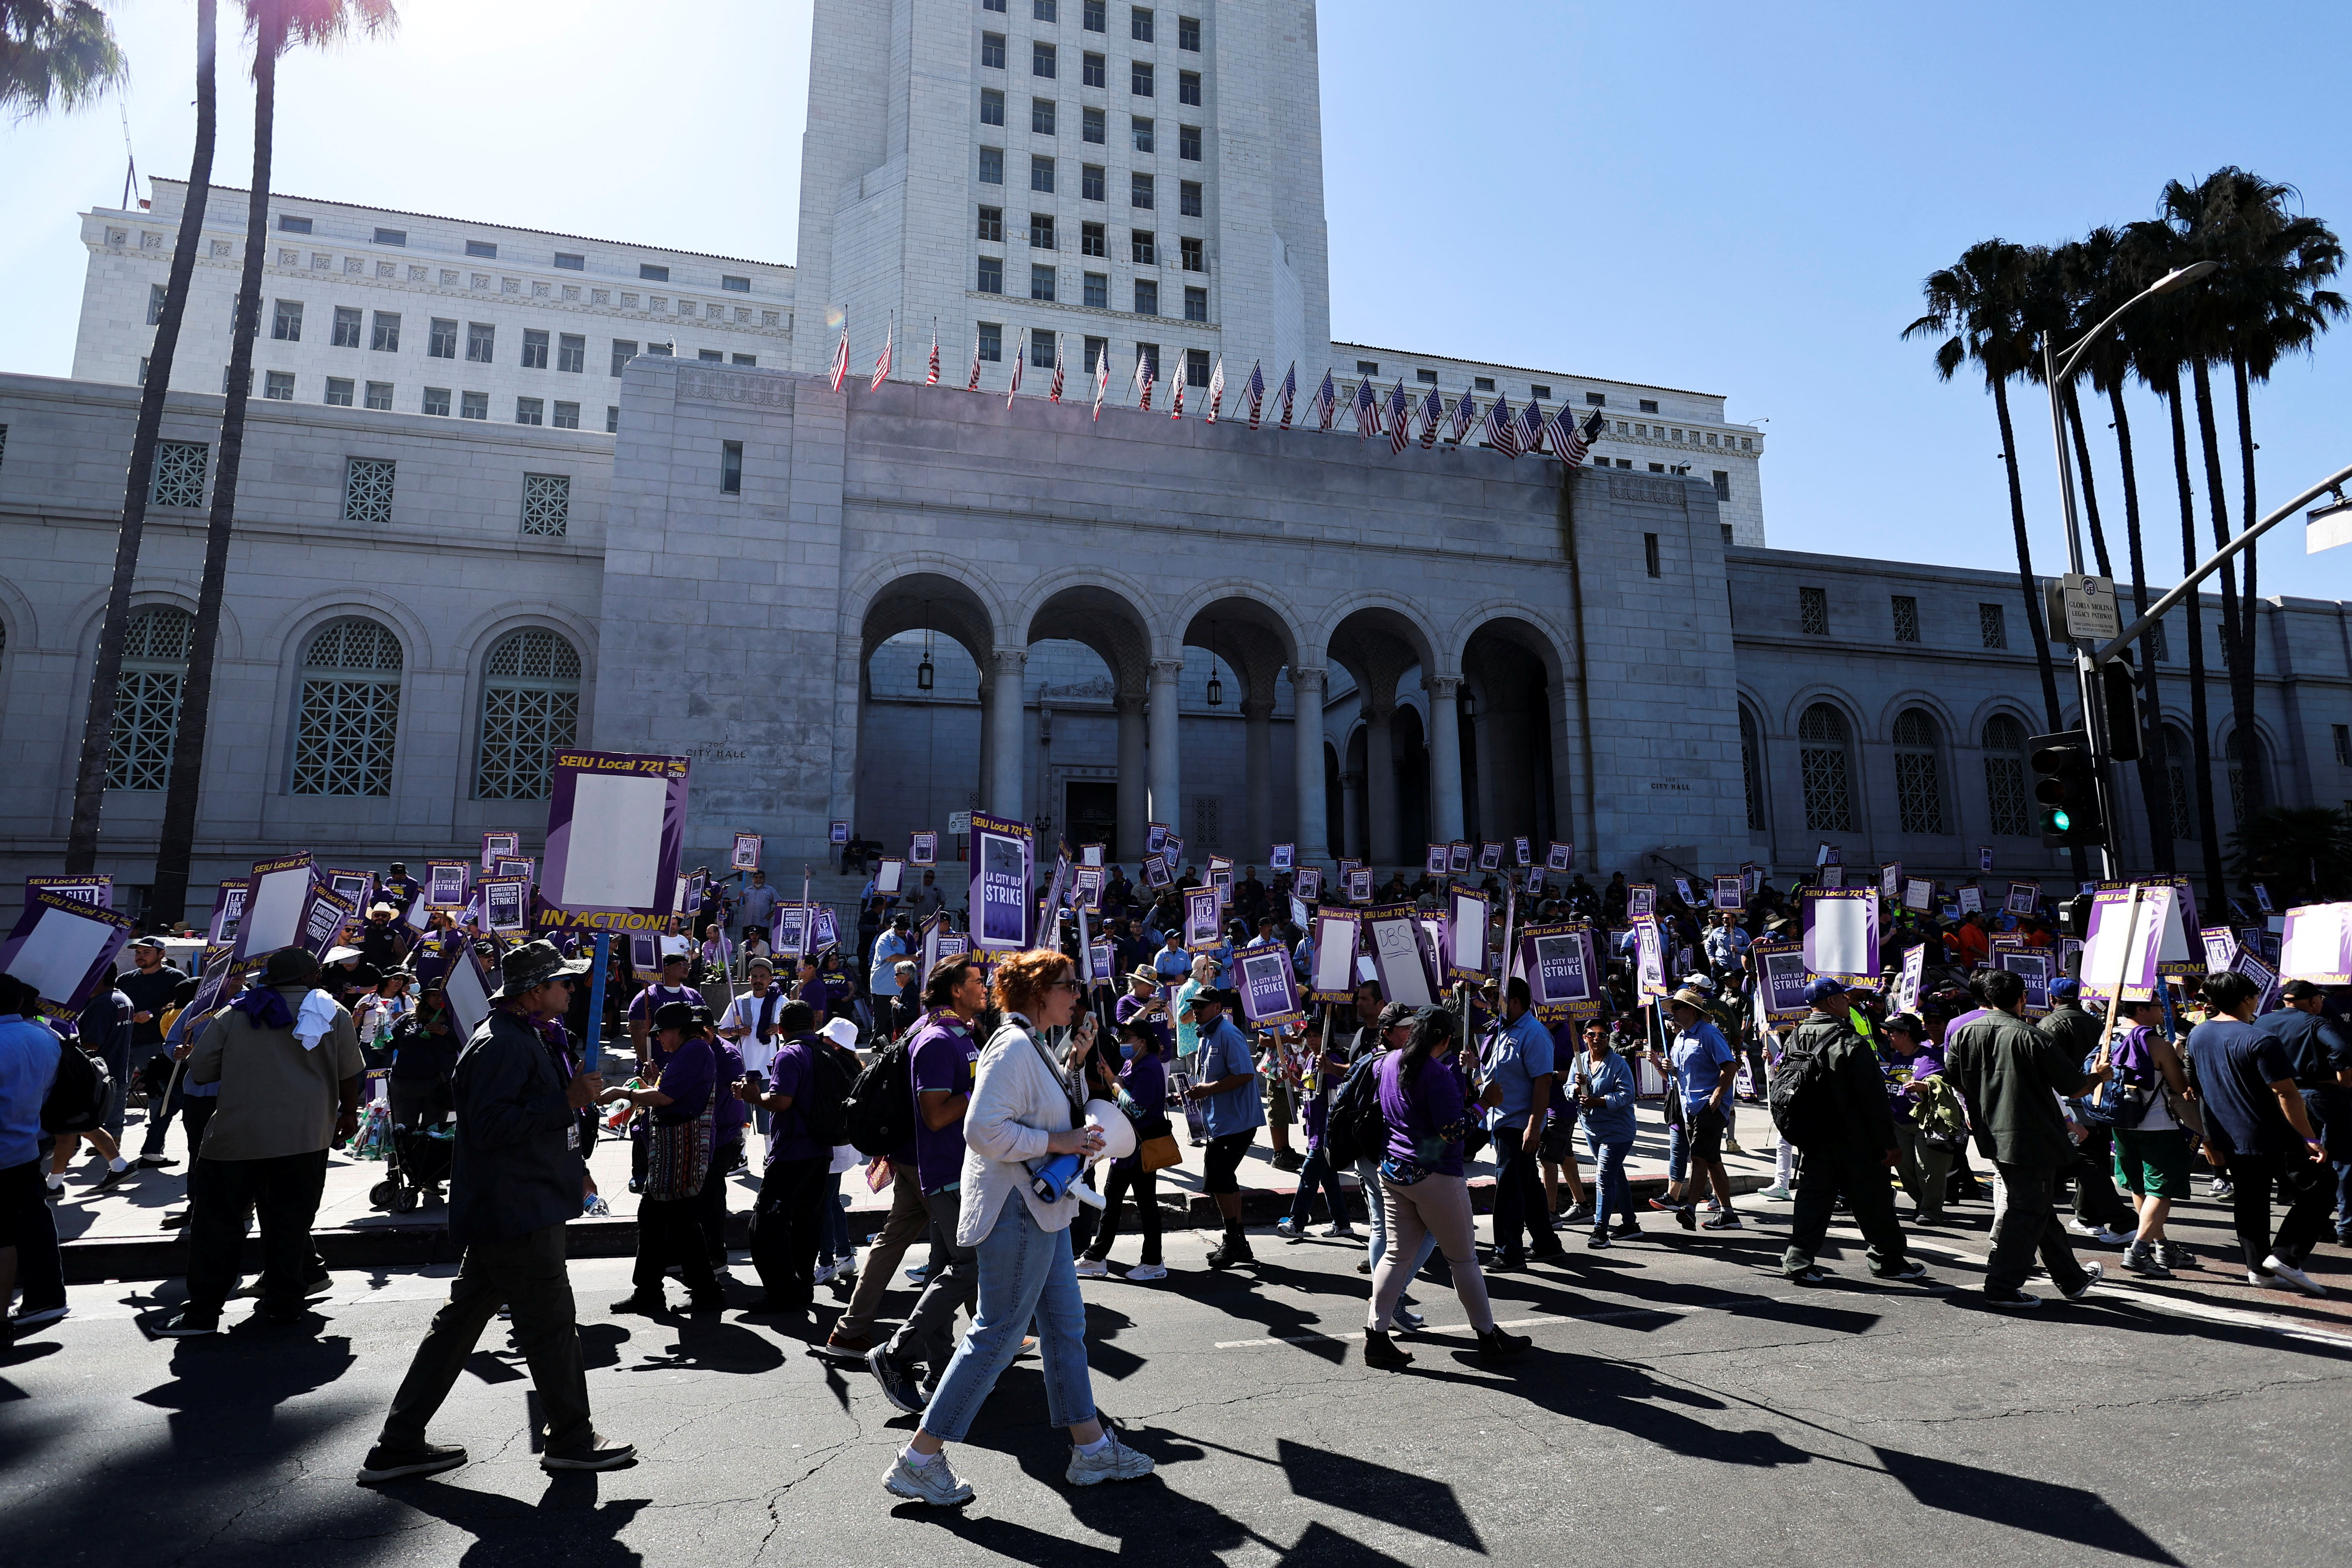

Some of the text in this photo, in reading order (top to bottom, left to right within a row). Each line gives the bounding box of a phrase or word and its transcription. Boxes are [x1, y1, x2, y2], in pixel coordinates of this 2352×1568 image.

[558, 756, 664, 771] SEIU Local 721
[972, 817, 1022, 835] SEIU Local 721
[253, 864, 273, 873] SEIU
[274, 860, 296, 868] Local
[986, 871, 1021, 887] LA CITY ULP
[491, 897, 517, 905] STRIKE!
[986, 884, 1021, 906] STRIKE
[37, 894, 117, 922] SEIU Local 721
[1196, 907, 1212, 918] ULP
[539, 910, 669, 931] IN ACTION!
[1379, 926, 1411, 951] DBS
[1196, 942, 1221, 951] ACTION!
[972, 949, 984, 963] IN
[2240, 944, 2276, 973] SEIU Local 721
[638, 972, 662, 981] ACTION!
[1449, 968, 1486, 981] IN ACTION!
[1544, 964, 1581, 977] STRIKE
[2244, 965, 2261, 980] WORKERS
[2245, 960, 2269, 980] SANITATION
[1253, 982, 1284, 996] STRIKE
[2080, 987, 2094, 997] IN
[1538, 1001, 1600, 1014] IN ACTION!
[1150, 1012, 1168, 1022] SEIU
[1263, 1012, 1302, 1025] ACTION!
[2189, 1133, 2199, 1151] SEIU
